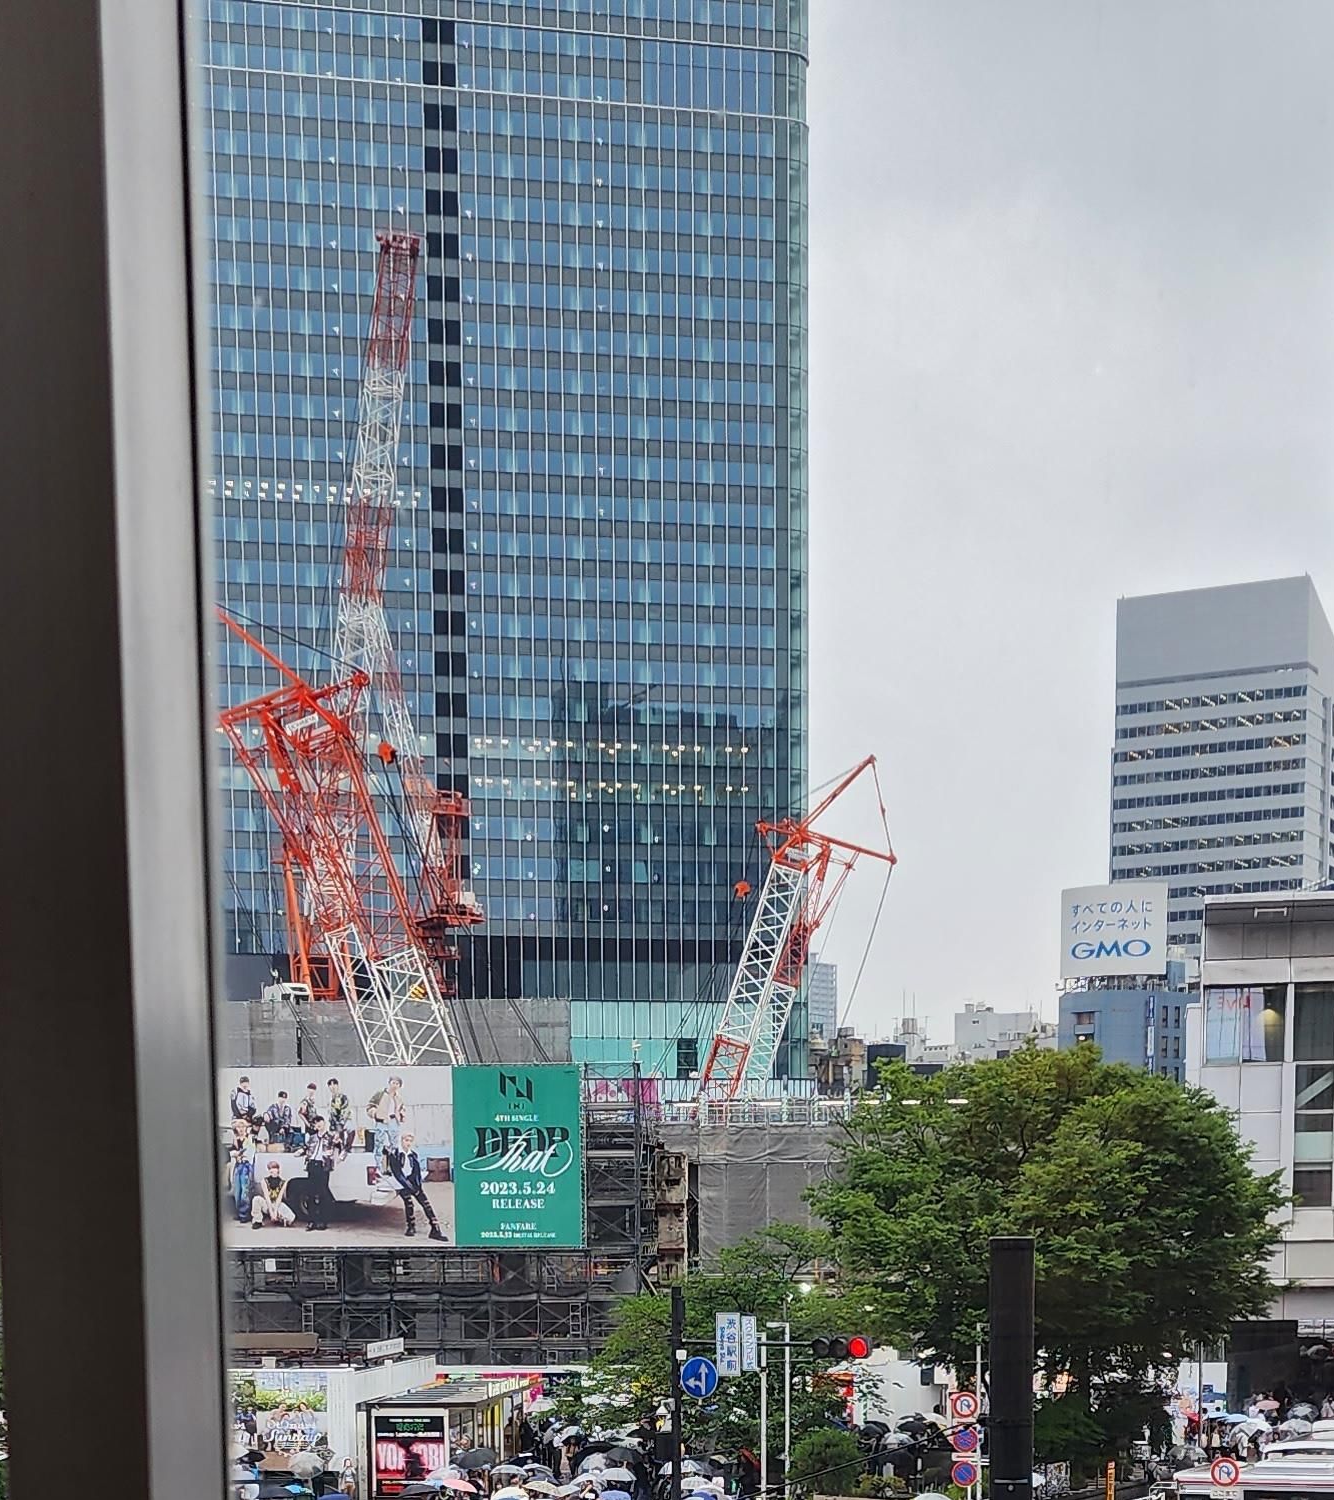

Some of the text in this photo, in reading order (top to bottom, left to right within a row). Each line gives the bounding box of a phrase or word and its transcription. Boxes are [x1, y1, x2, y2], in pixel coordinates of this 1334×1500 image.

[1071, 899, 1153, 918] すべての人に
[1071, 917, 1153, 935] インターネット
[1071, 939, 1152, 960] GMO
[461, 1130, 574, 1178] That
[479, 1181, 556, 1195] 2023.5.24
[492, 1198, 546, 1209] RELEASE
